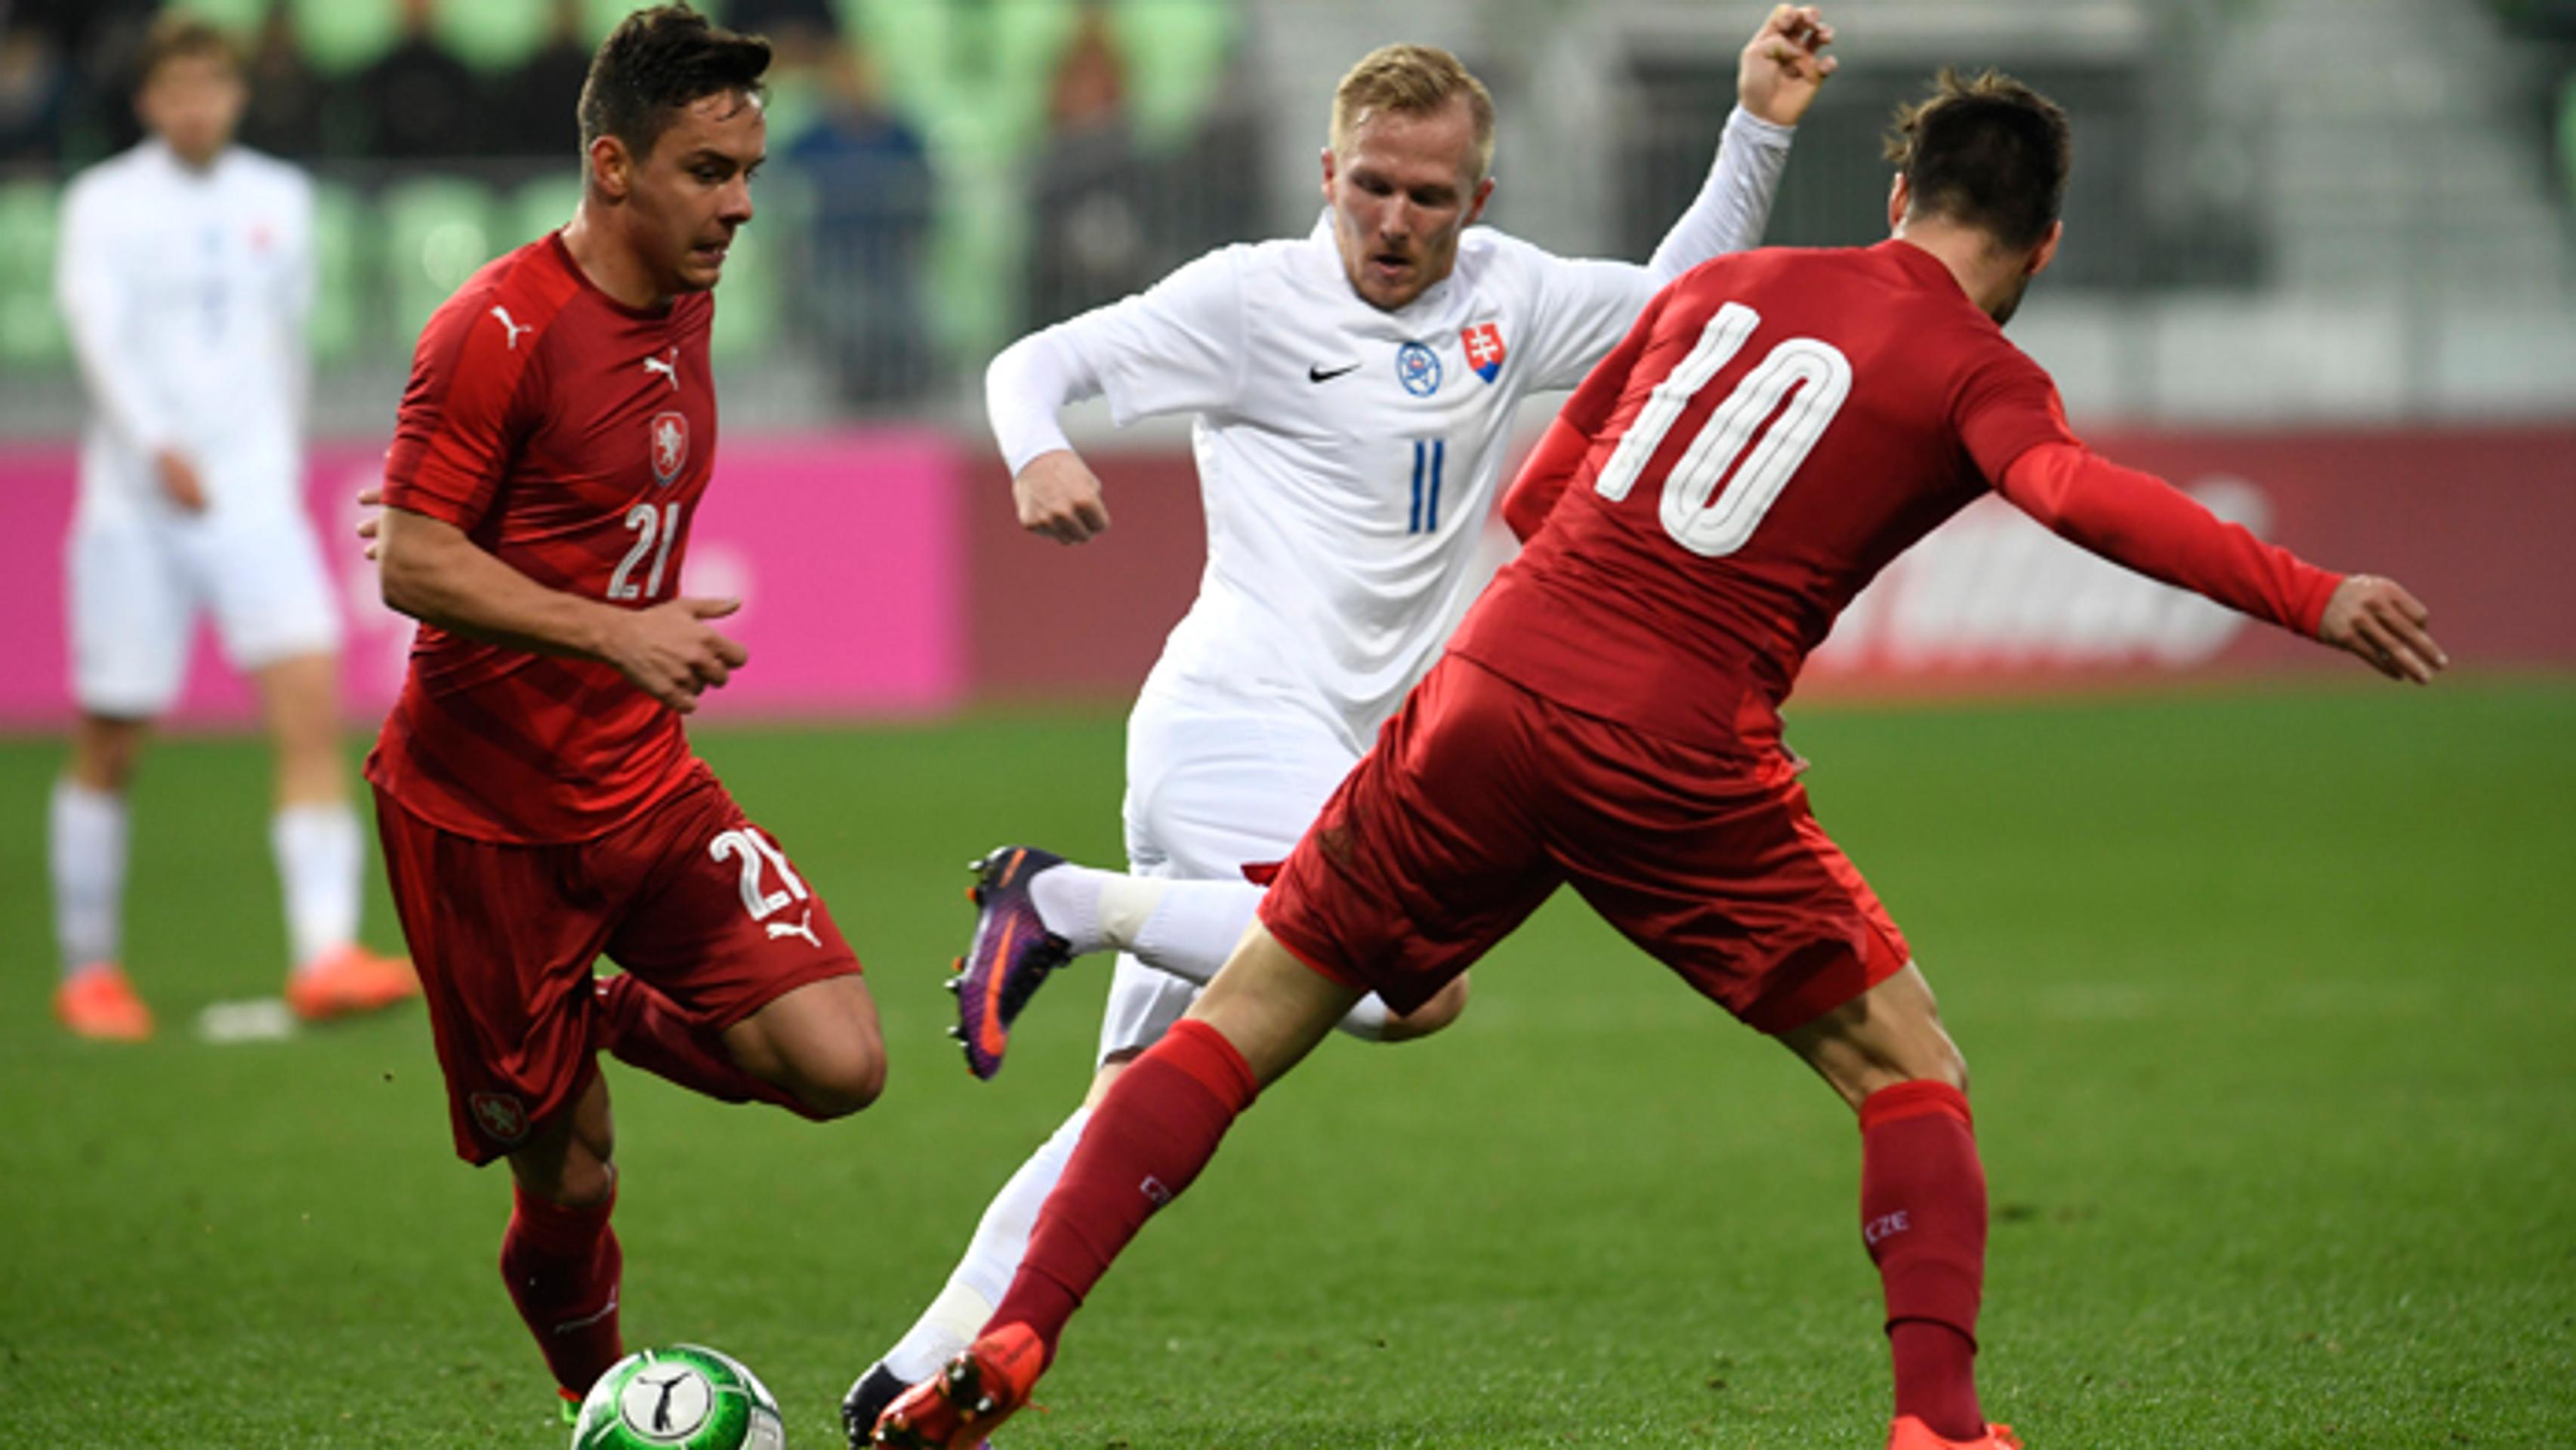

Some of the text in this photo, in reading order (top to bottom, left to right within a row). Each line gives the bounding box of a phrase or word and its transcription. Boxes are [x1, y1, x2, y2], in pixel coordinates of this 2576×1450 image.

[1594, 302, 1853, 557] 10
[1408, 439, 1444, 534] 11
[606, 503, 681, 600] 21
[709, 828, 808, 921] 21
[1865, 1210, 1910, 1245] CZE
